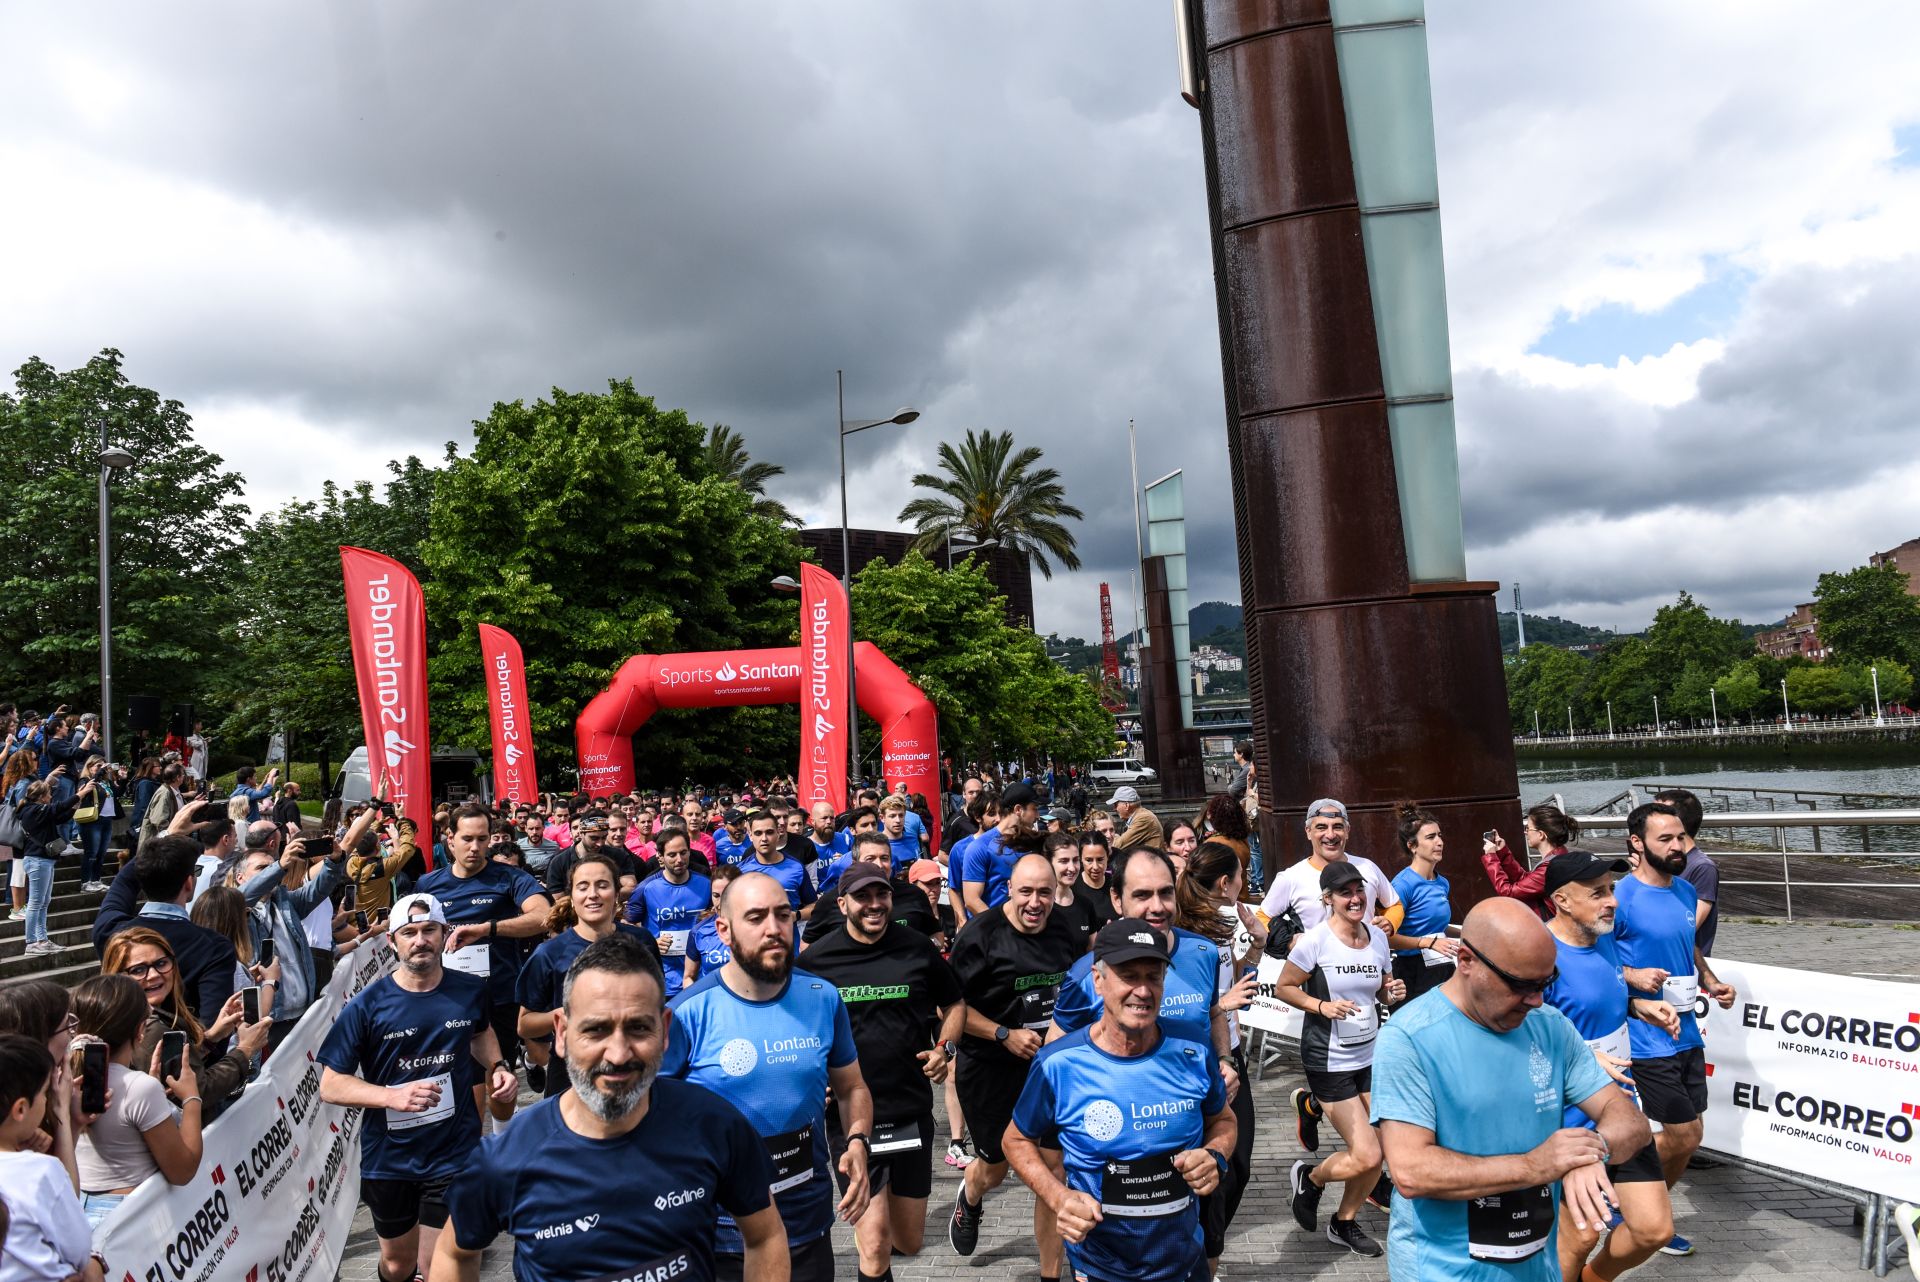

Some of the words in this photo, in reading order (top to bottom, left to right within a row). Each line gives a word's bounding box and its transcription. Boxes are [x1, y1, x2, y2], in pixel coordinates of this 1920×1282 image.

[660, 668, 712, 688] Sports
[740, 663, 801, 680] Santan
[893, 740, 919, 749] Sports
[584, 754, 608, 763] Sports
[891, 752, 931, 761] Santander
[584, 765, 621, 775] Santander
[656, 906, 685, 921] IGN
[1159, 1007, 1185, 1018] Group
[1261, 1001, 1272, 1009] CON
[1272, 1003, 1290, 1013] VALOR
[1742, 1003, 1775, 1031] EL
[1780, 1009, 1920, 1053] CORREO
[763, 1036, 821, 1053] Lontana
[413, 1053, 455, 1068] COFARES
[766, 1054, 798, 1064] Group
[1778, 1041, 1848, 1060] INFORMAZIO
[1852, 1053, 1919, 1073] BALIOTSUA
[1131, 1098, 1194, 1119] Lontana
[1733, 1081, 1769, 1113] EL
[1775, 1091, 1913, 1143] CORREO
[1133, 1120, 1167, 1131] Group
[1769, 1122, 1842, 1148] INFORMACIÓN
[1845, 1140, 1870, 1154] CON
[1873, 1147, 1912, 1165] VALOR
[234, 1160, 256, 1199] EL
[251, 1113, 292, 1179] CORREO
[782, 1147, 800, 1158] GROUP
[1121, 1176, 1152, 1185] LONTANA
[1152, 1171, 1173, 1181] GROUP
[1151, 1189, 1171, 1199] ÁNGEL
[1512, 1210, 1529, 1220] CABB
[166, 1189, 230, 1281] CORREO
[283, 1197, 320, 1272] CORREO
[534, 1223, 573, 1241] welnia
[1508, 1228, 1532, 1239] IGNACIO
[213, 1245, 227, 1264] CON
[223, 1226, 240, 1250] VALOR
[611, 1254, 688, 1282] FARES
